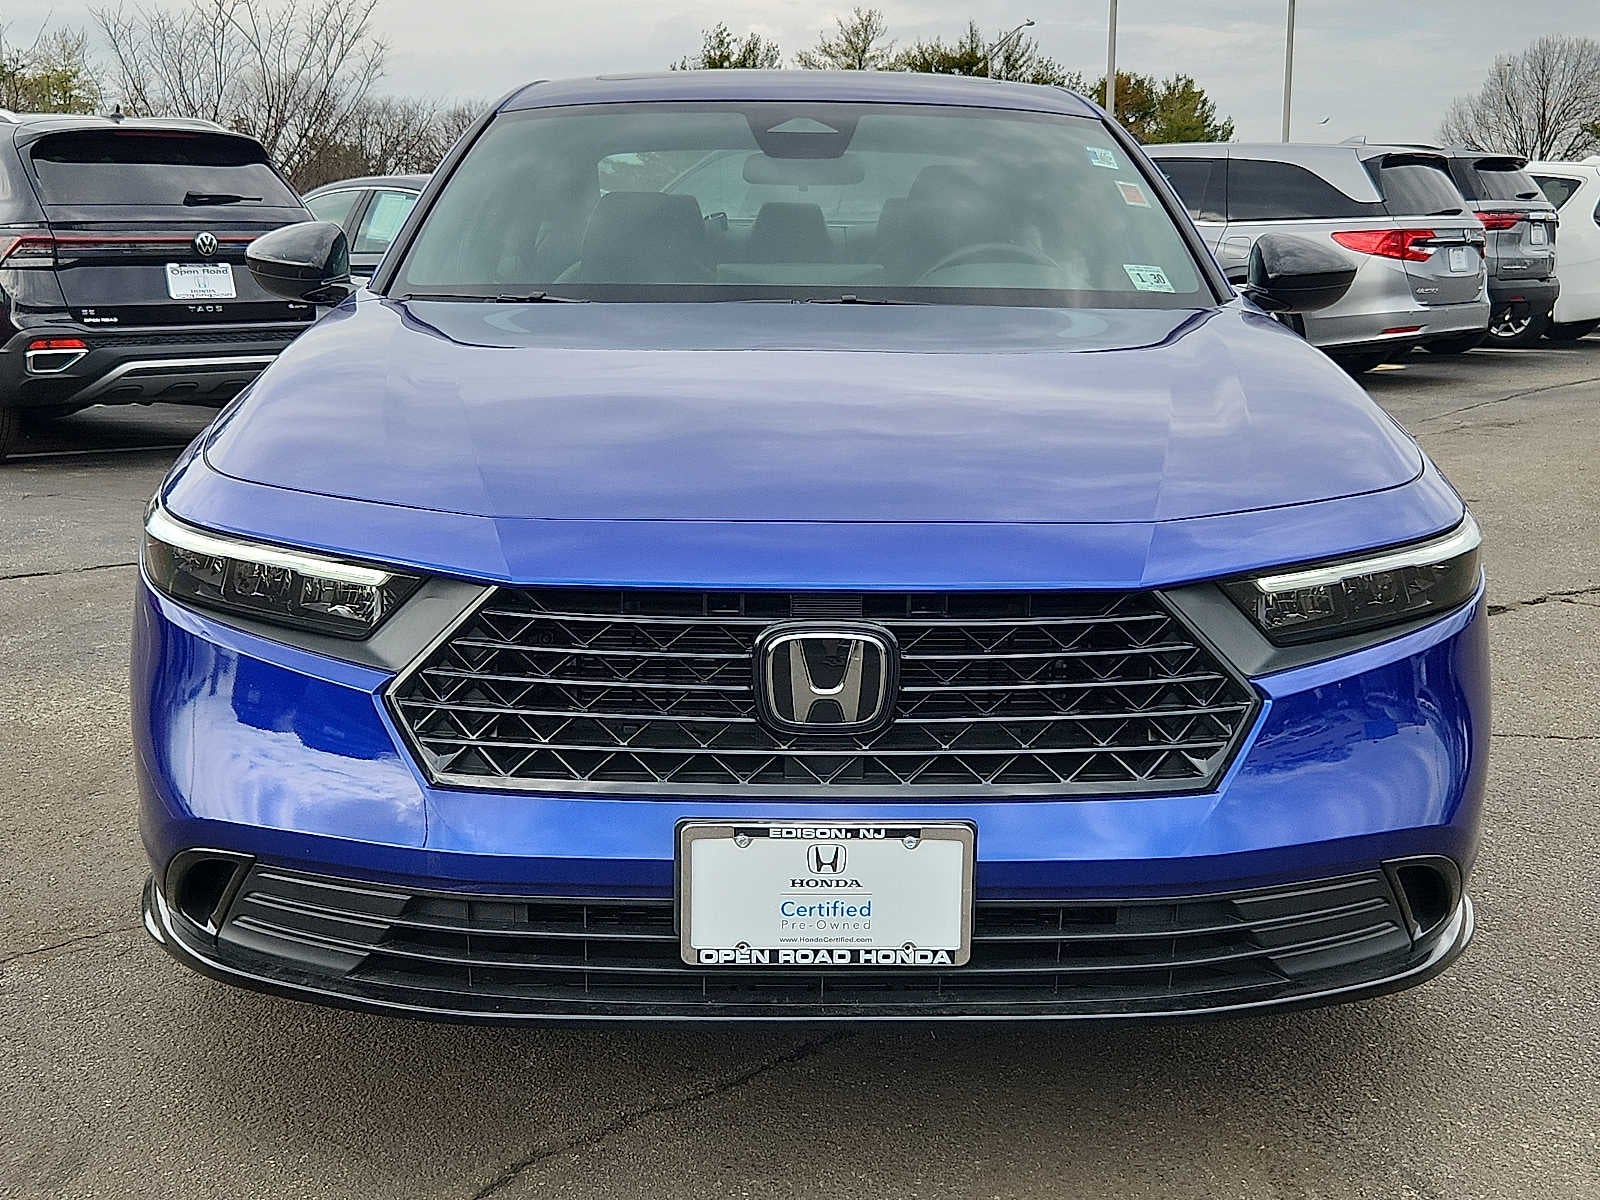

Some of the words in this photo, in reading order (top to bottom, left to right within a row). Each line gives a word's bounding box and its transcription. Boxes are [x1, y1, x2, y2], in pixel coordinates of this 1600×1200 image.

[170, 268, 199, 276] Open
[769, 828, 851, 839] EDISON,
[859, 828, 886, 839] NJ
[789, 879, 863, 888] HONDA
[781, 900, 871, 917] Certified
[781, 919, 871, 930] Pre-Owned
[700, 949, 770, 964] OPEN
[778, 949, 851, 964] ROAD
[860, 949, 951, 964] HONDA
